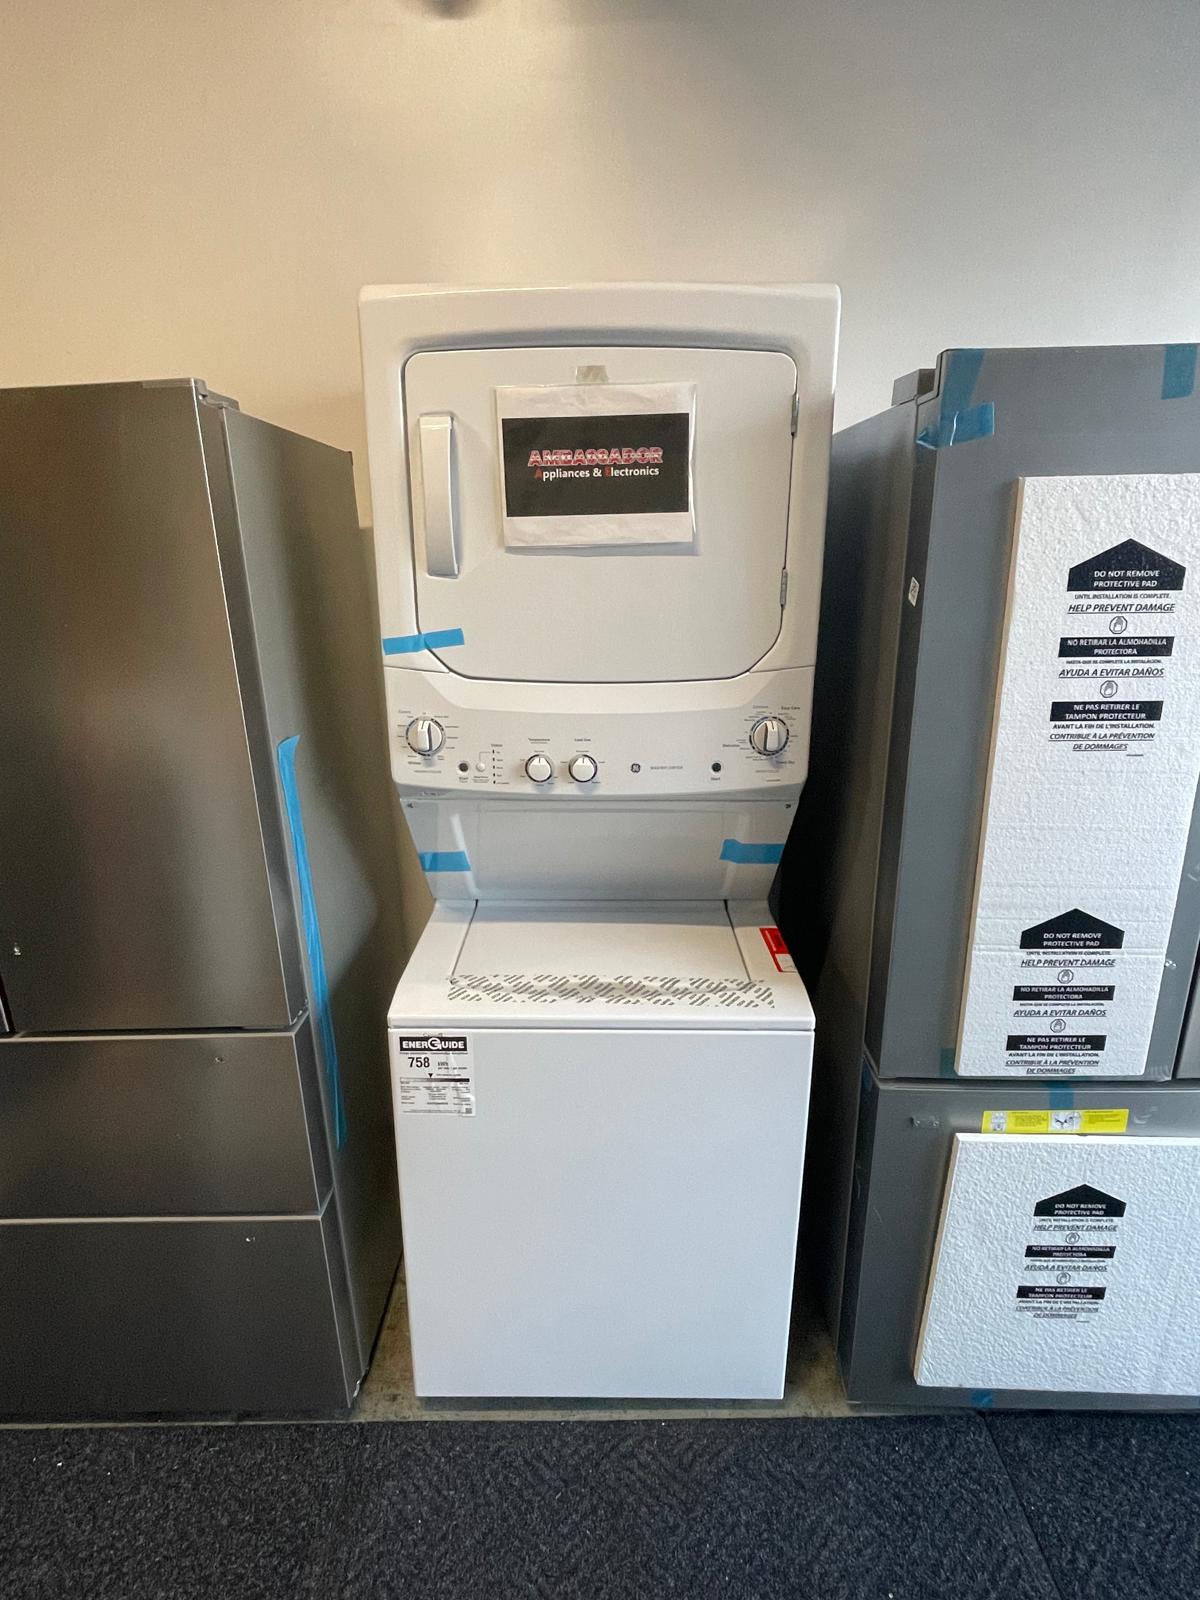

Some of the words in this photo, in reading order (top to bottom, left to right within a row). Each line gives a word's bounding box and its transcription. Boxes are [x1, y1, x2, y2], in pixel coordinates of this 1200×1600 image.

[528, 447, 663, 466] AMBASSADOR
[535, 468, 590, 481] Appliances
[593, 468, 602, 477] &
[605, 466, 659, 478] Electronics
[1094, 570, 1106, 578] DO
[1108, 570, 1124, 578] NOT
[1127, 570, 1160, 578] REMOVE
[1068, 604, 1092, 612] HELP
[1092, 604, 1134, 612] PREVENT
[1135, 604, 1175, 612] DAMAGE
[1059, 668, 1089, 677] AYUDA
[1092, 668, 1097, 677] A
[1100, 668, 1130, 677] EVITAR
[1132, 668, 1164, 677] DAÑOS
[402, 1038, 464, 1050] ENERGUIDE
[408, 1057, 430, 1068] 758
